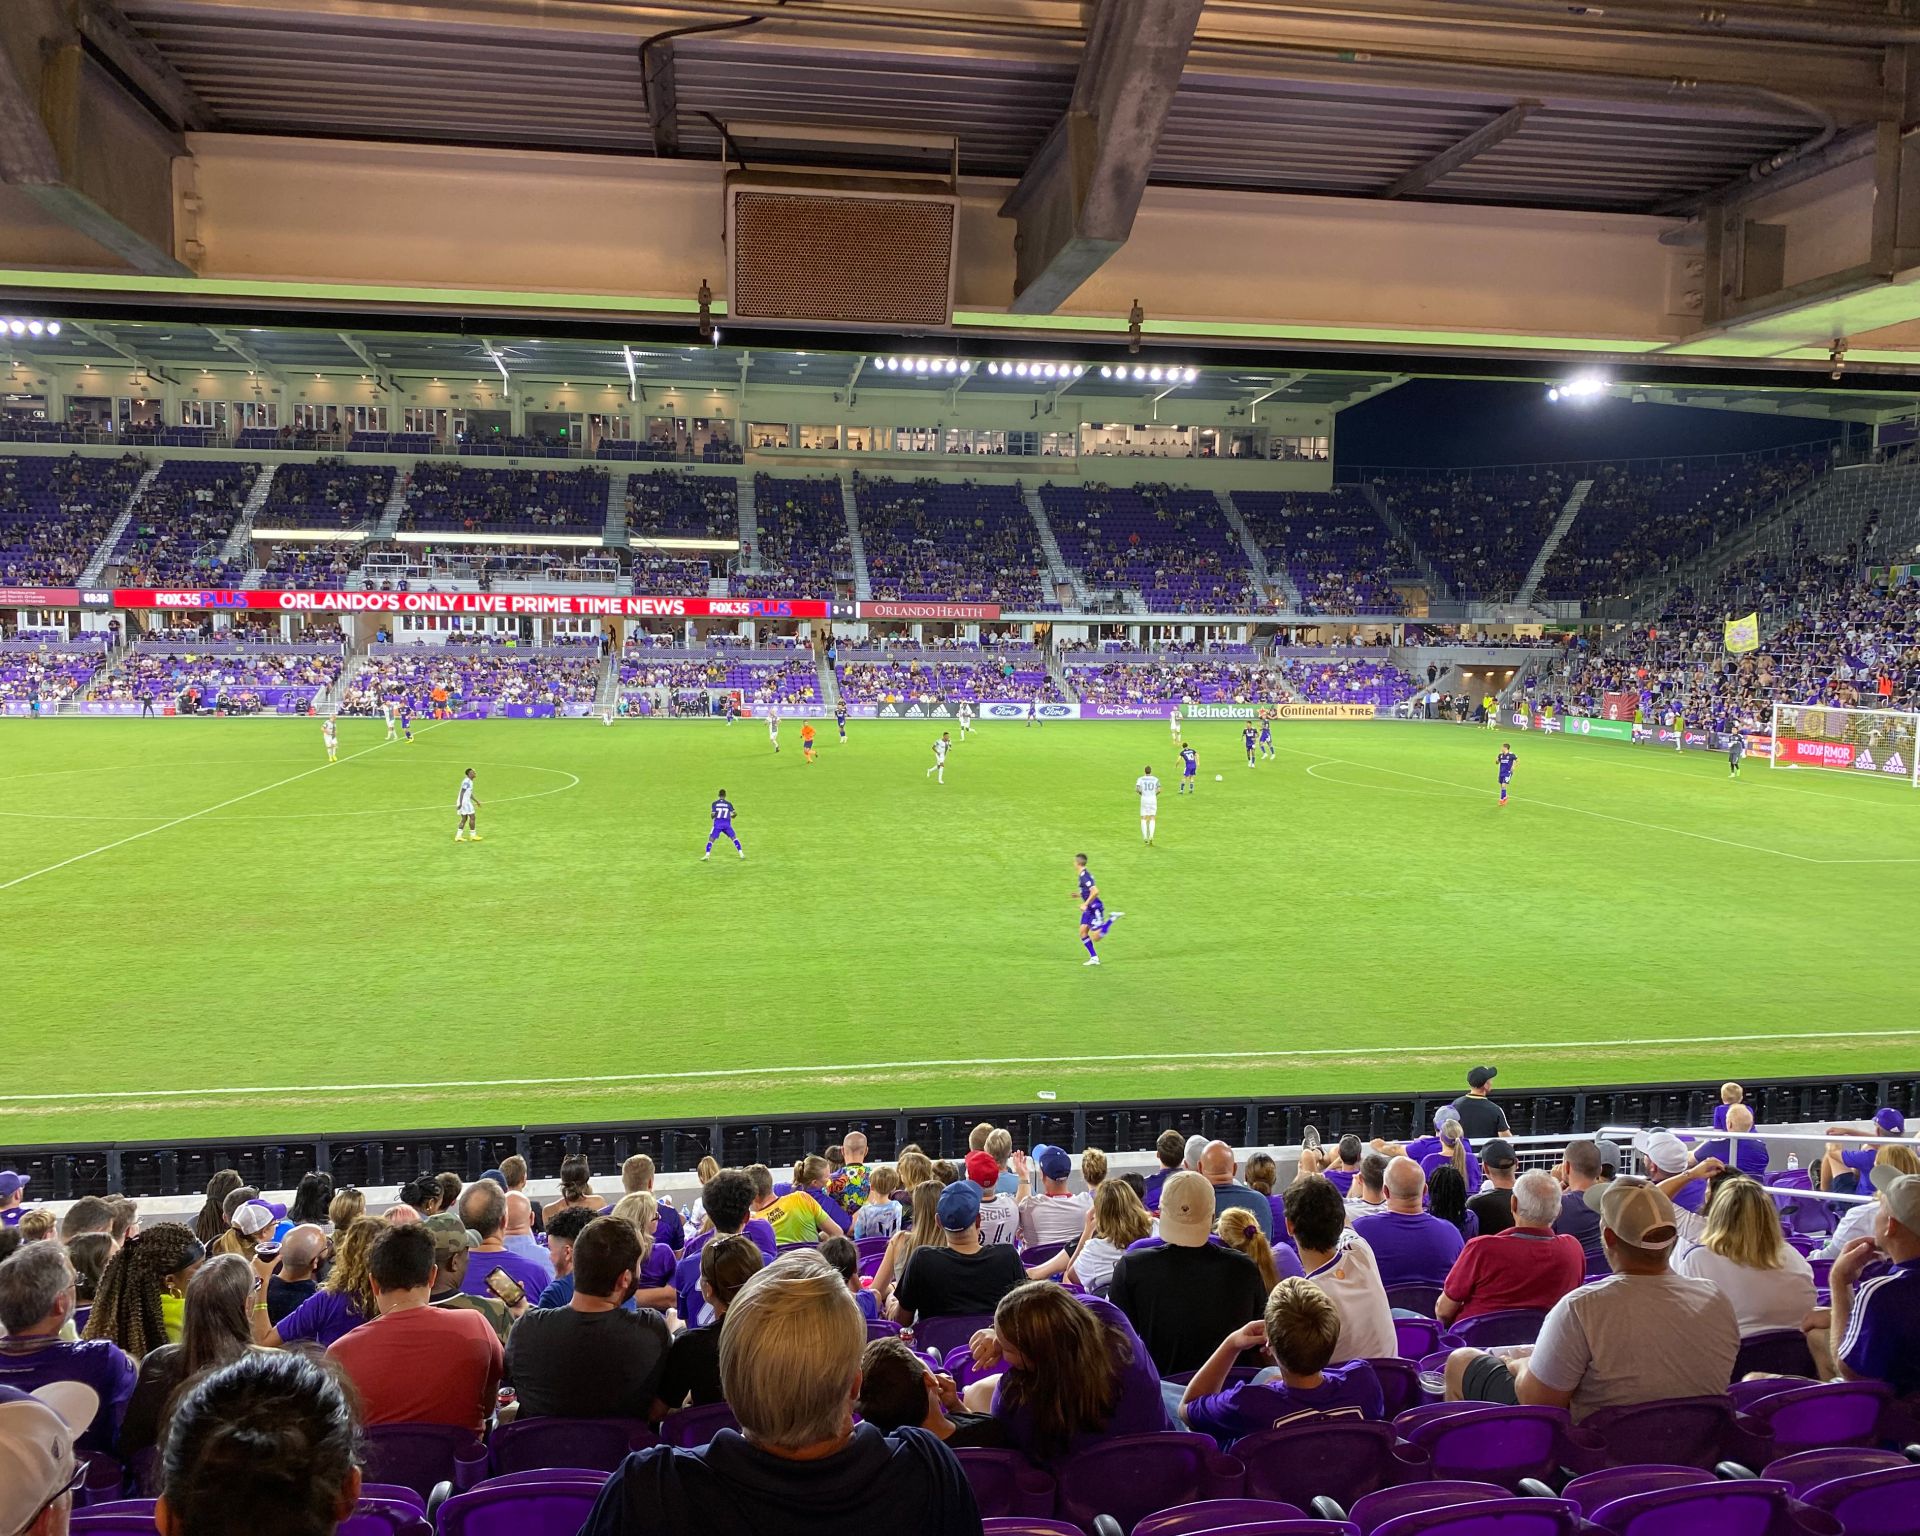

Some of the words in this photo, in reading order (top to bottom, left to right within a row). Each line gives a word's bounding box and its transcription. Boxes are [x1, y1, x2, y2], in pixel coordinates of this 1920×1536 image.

[279, 593, 400, 609] ORLANDO'S
[404, 595, 458, 611] ONLY
[463, 596, 507, 612] LIVE
[512, 597, 572, 613] PRIME
[576, 598, 623, 614] TIME
[627, 599, 685, 615] NEWS
[874, 605, 936, 616] ORLANDO
[937, 605, 983, 617] HEALTH
[994, 706, 1020, 716] Ford
[1043, 706, 1068, 716] Ford
[1187, 705, 1254, 718] Heineken
[1280, 705, 1338, 717] Continental
[1349, 708, 1371, 716] TIRE
[1797, 743, 1850, 760] BODYARMOR
[1143, 781, 1155, 791] 10
[715, 807, 729, 818] 77
